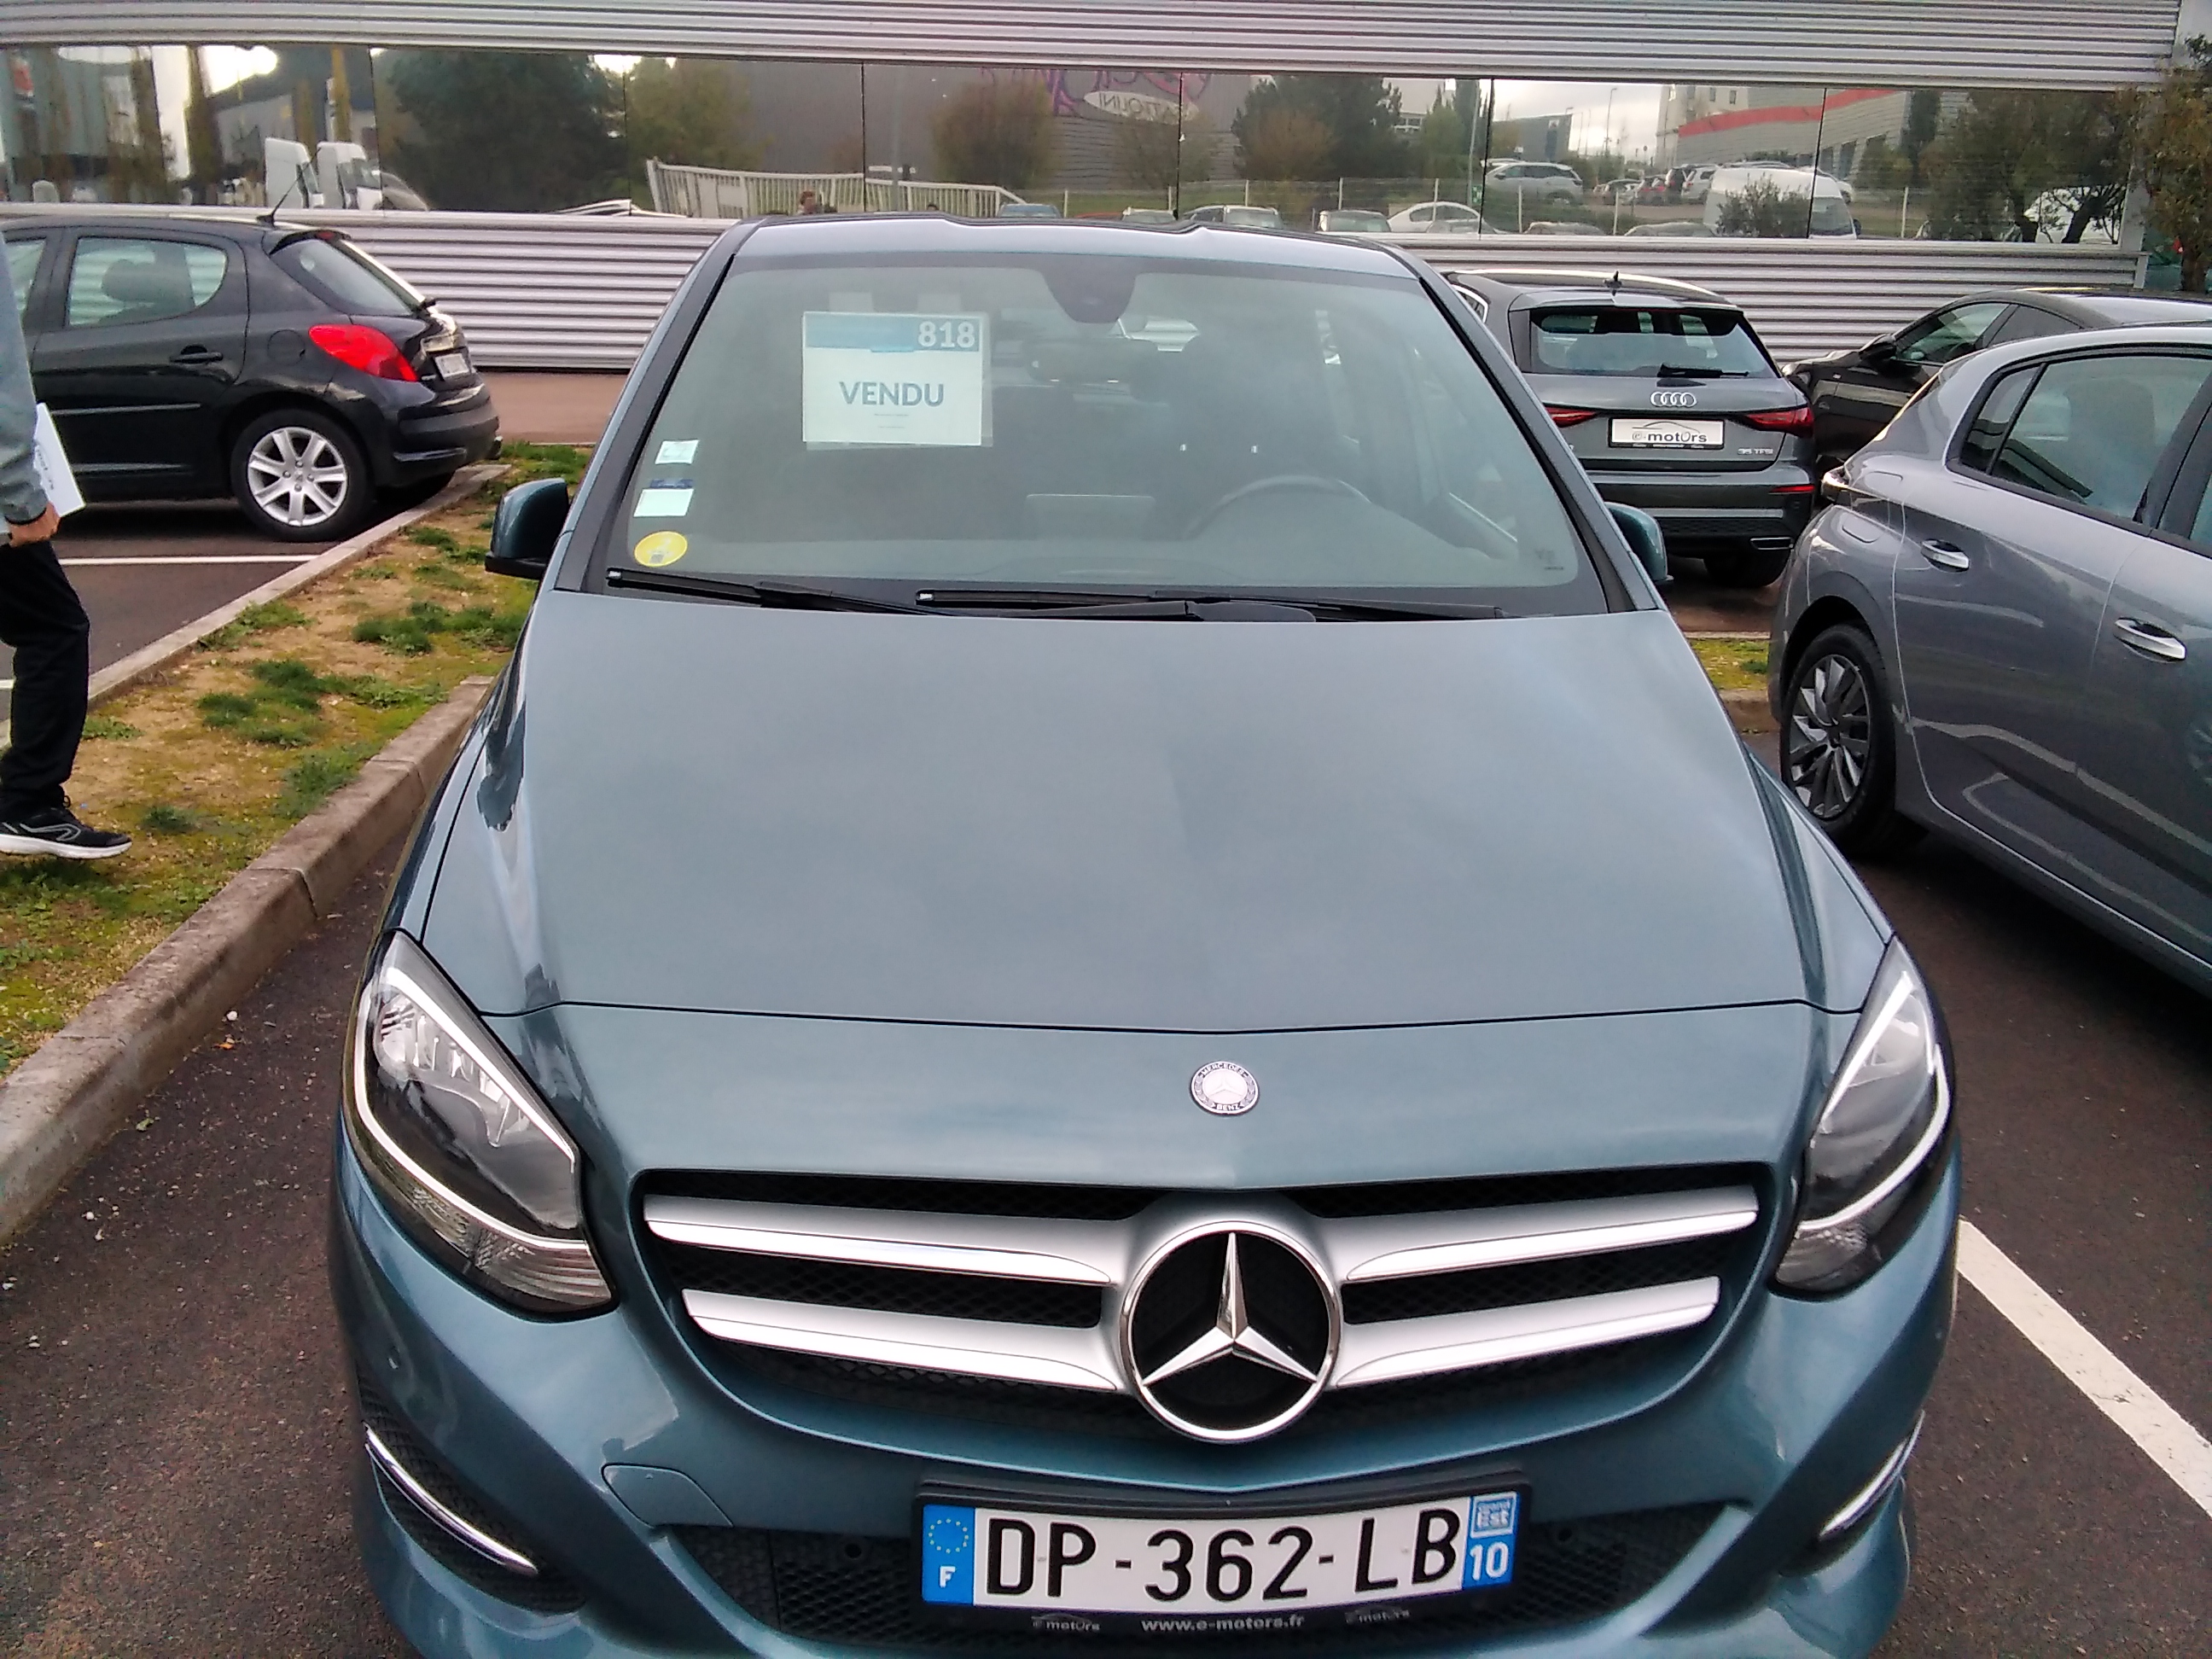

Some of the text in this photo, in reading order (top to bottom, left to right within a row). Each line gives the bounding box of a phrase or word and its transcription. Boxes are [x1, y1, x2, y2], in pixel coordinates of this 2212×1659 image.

[917, 321, 975, 348] 818
[839, 381, 944, 407] VENDU
[1470, 1541, 1508, 1580] 10
[939, 1566, 957, 1588] F
[1141, 1614, 1304, 1632] www.e-motors.fr
